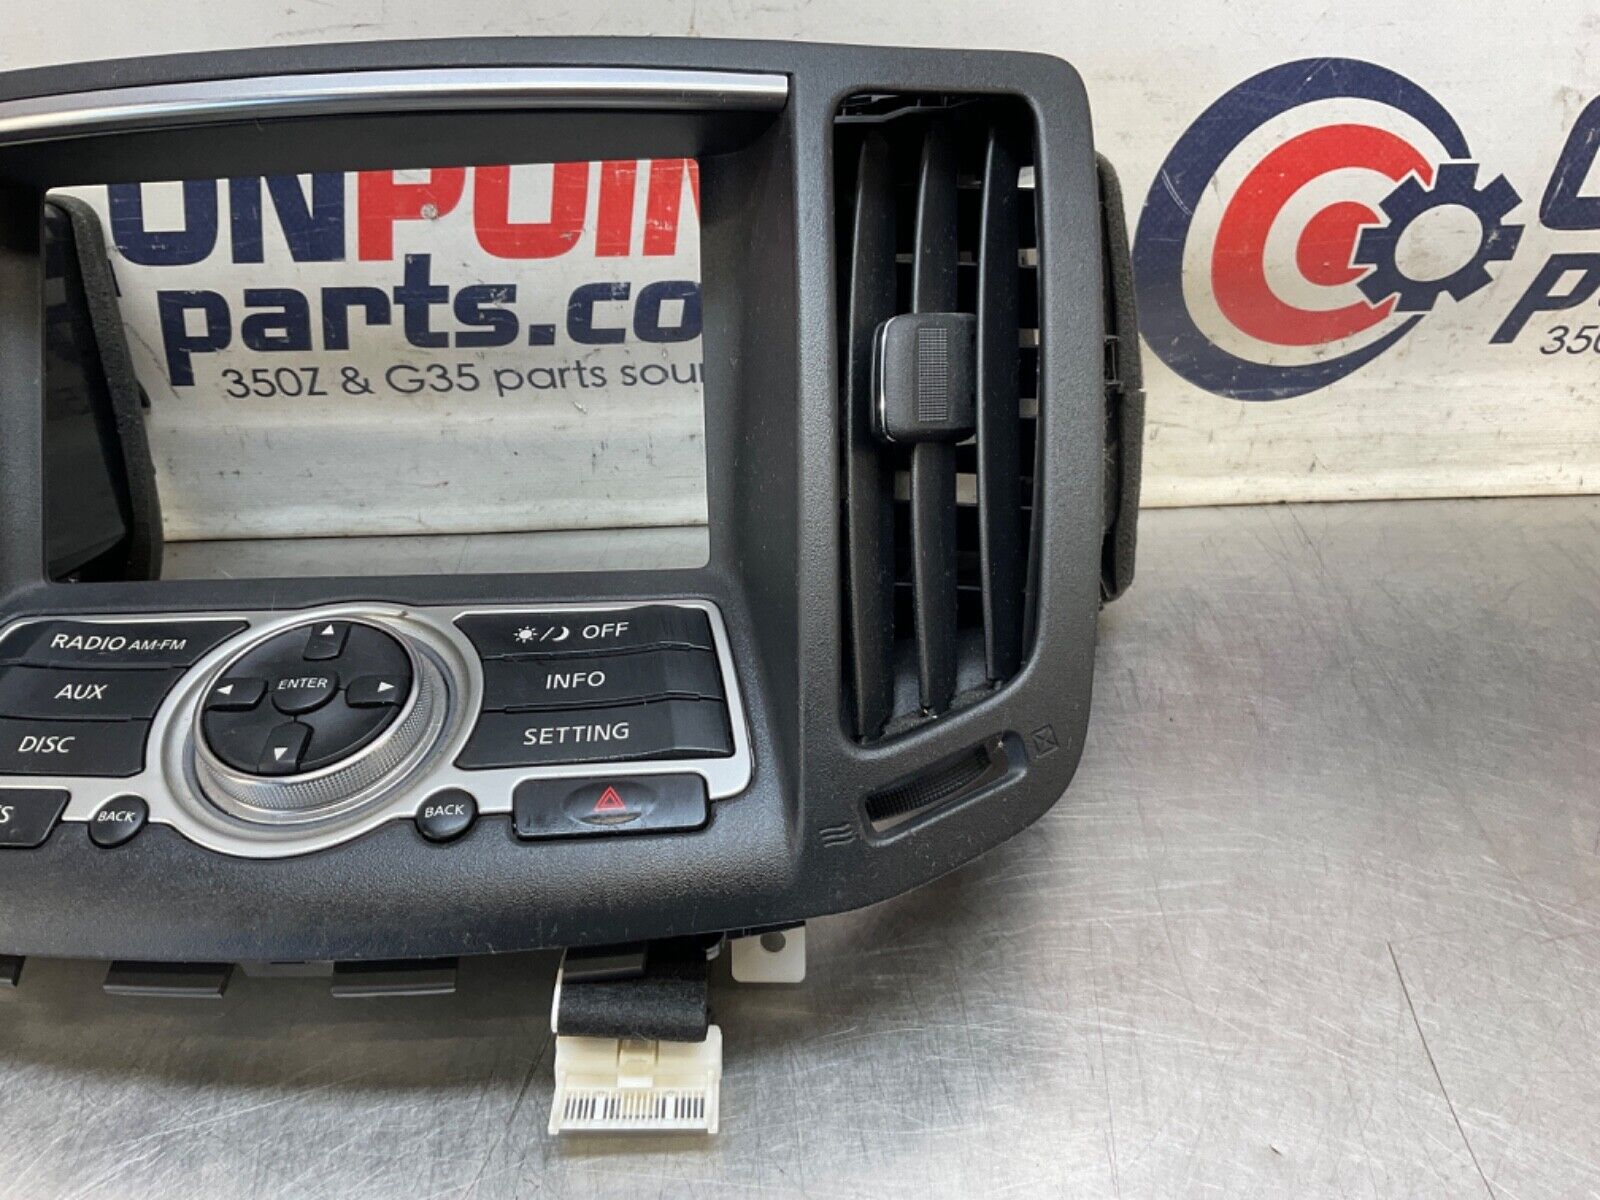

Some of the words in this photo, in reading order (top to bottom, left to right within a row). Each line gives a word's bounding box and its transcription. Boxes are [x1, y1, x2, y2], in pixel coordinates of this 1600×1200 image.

[221, 366, 328, 398] 350Z
[340, 366, 375, 395] &
[385, 362, 480, 393] G35
[493, 360, 607, 397] parts
[620, 363, 704, 387] sou
[582, 621, 630, 639] OFF
[50, 633, 126, 651] RADIO
[277, 677, 328, 690] ENTER
[545, 671, 606, 690] INFO
[54, 684, 108, 700] AUX
[523, 722, 630, 746] SETTING
[17, 736, 76, 753] DISC
[97, 811, 136, 823] BACK
[424, 804, 465, 818] BACK
